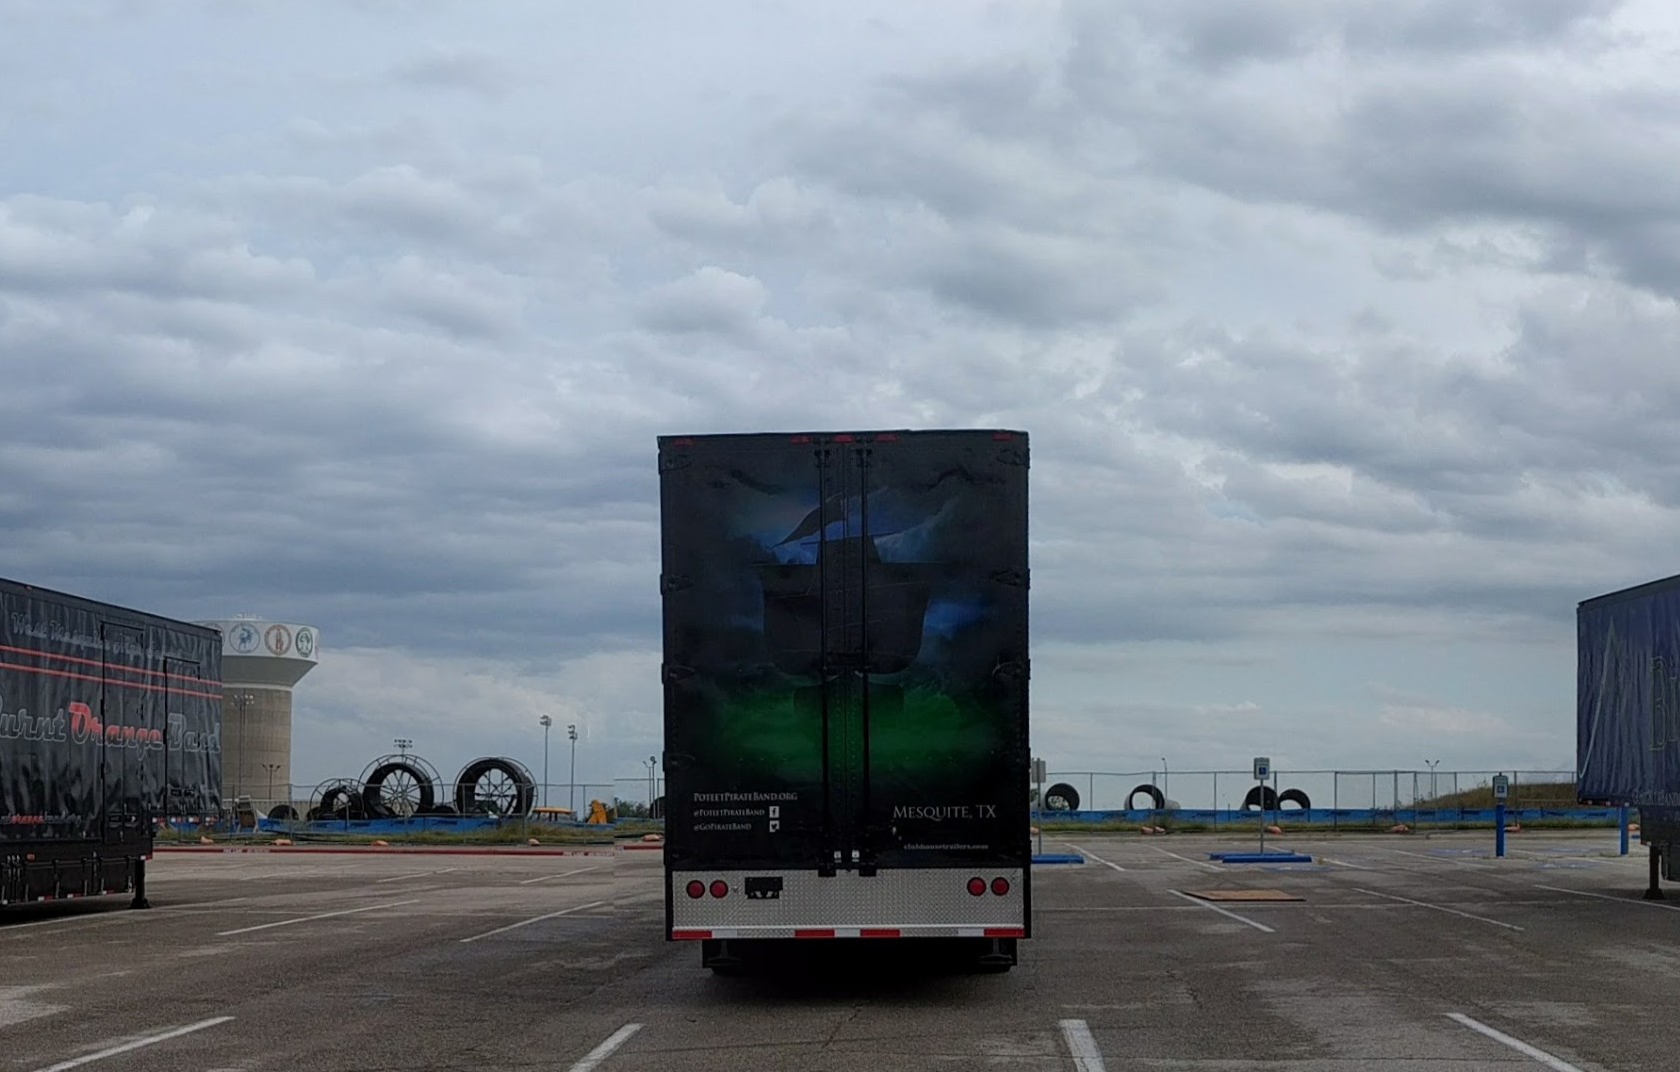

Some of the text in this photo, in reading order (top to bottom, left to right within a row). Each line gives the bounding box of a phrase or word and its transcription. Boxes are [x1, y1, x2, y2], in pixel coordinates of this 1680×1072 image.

[69, 701, 166, 761] Orange
[893, 804, 997, 822] MESQUITE, TX
